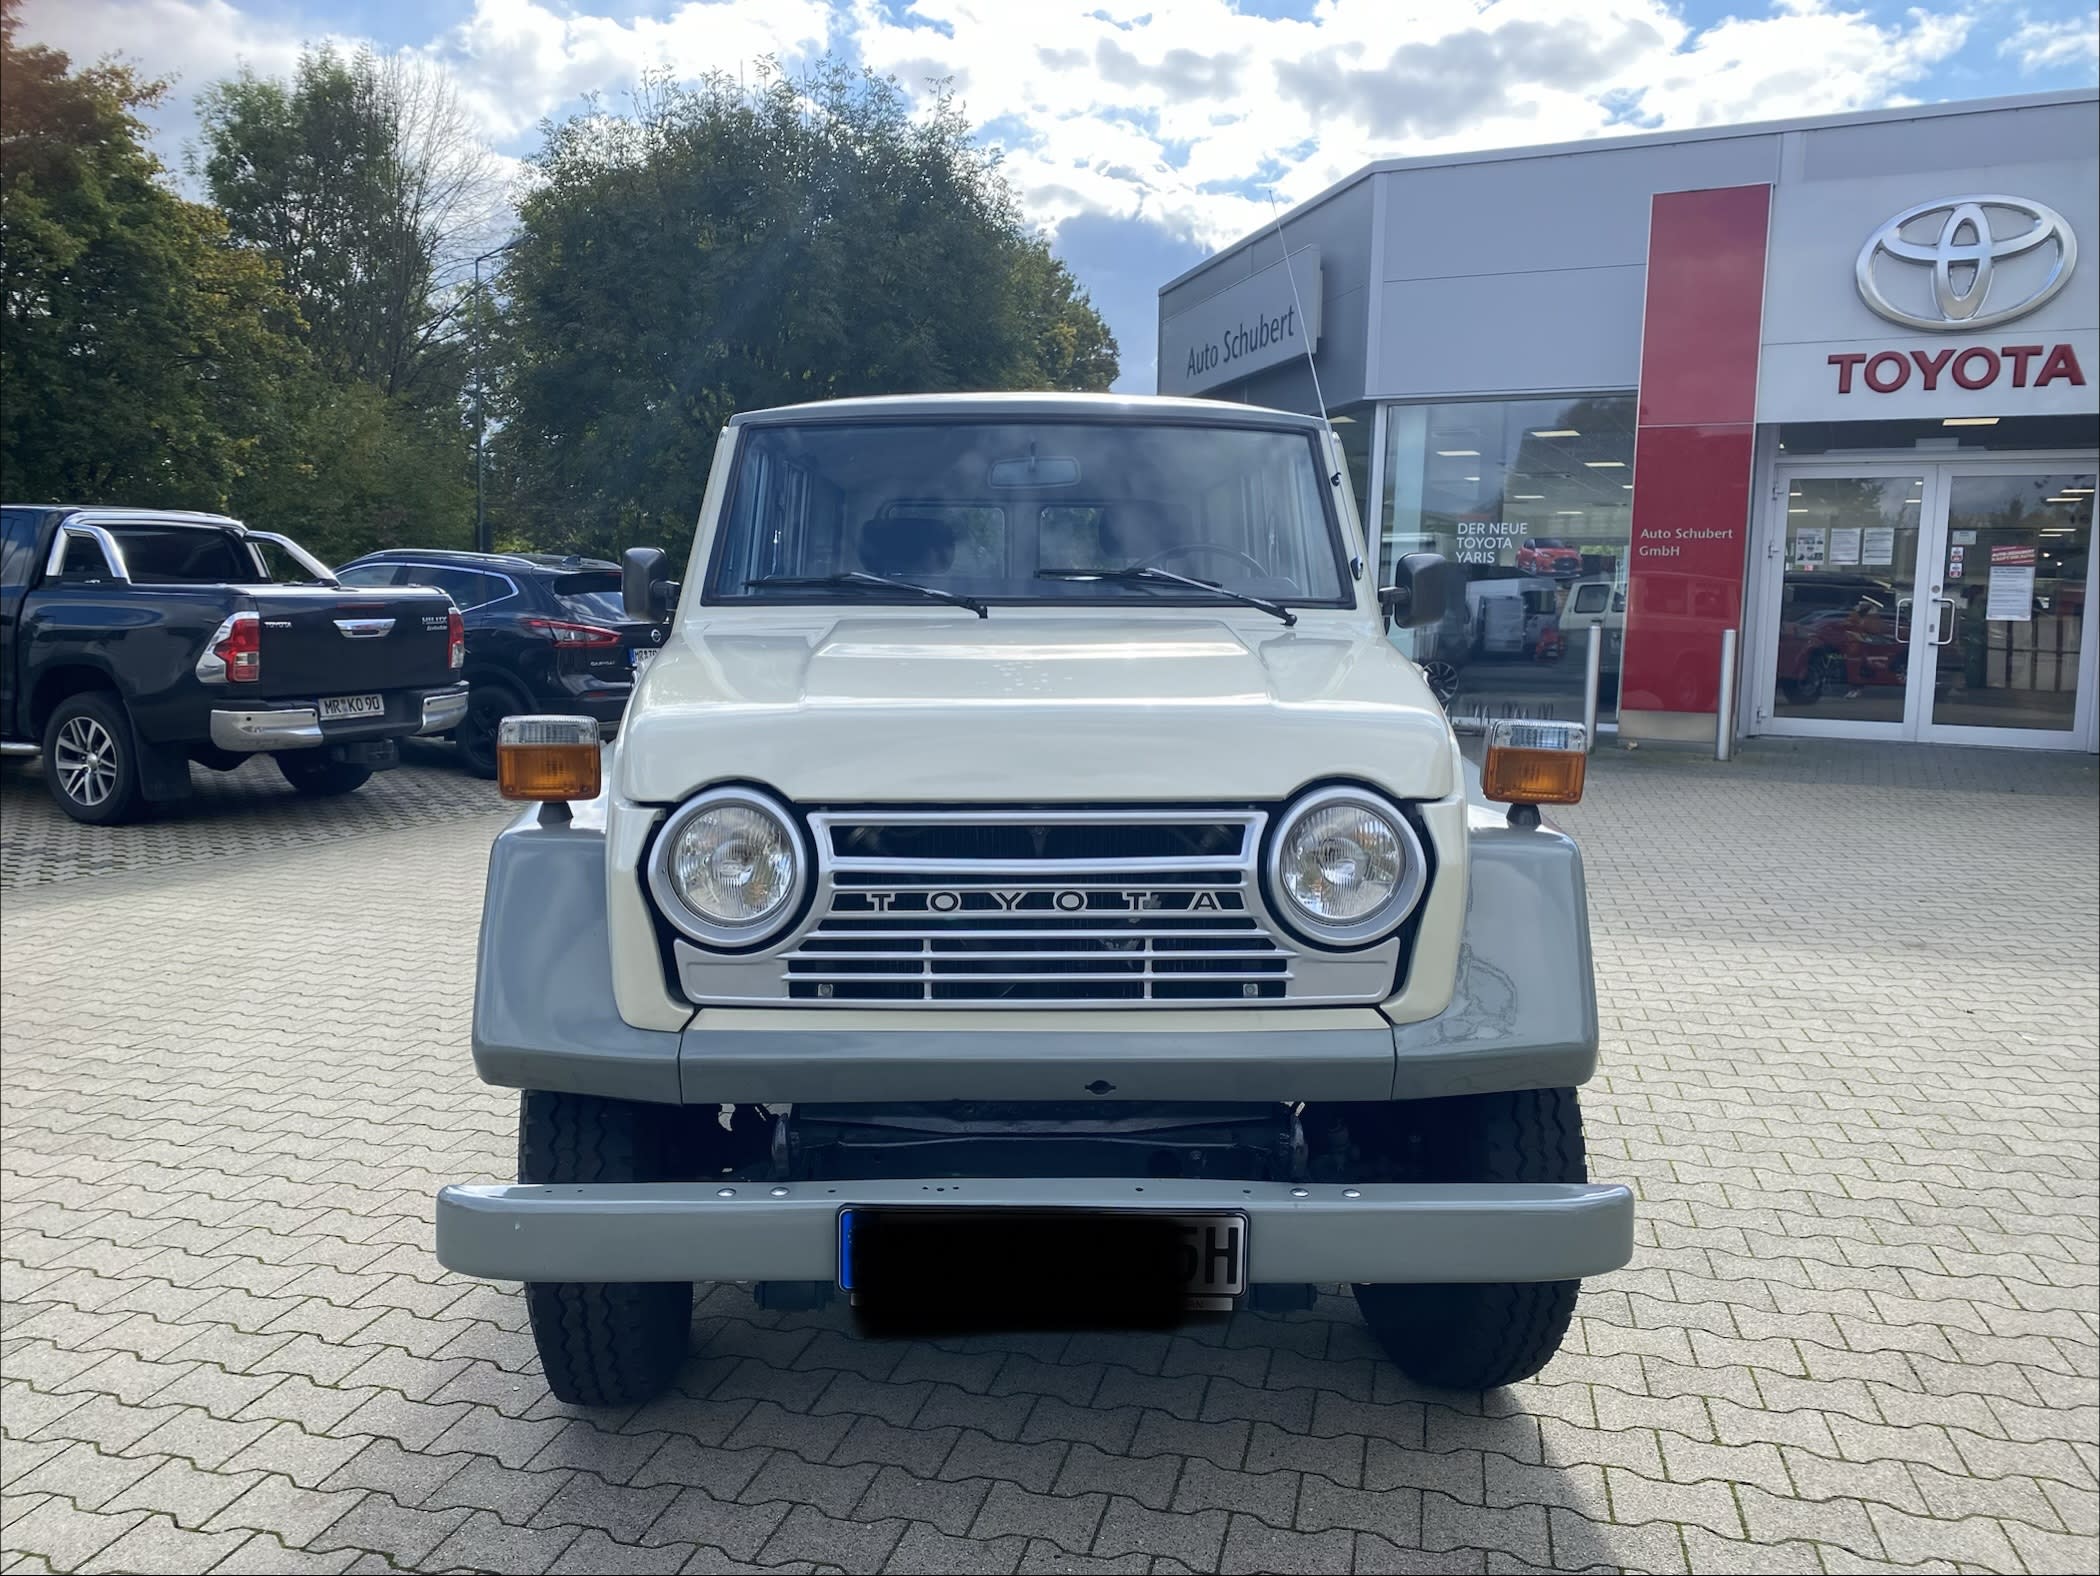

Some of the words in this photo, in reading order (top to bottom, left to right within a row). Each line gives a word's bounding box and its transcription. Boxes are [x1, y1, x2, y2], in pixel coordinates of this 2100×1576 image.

[1186, 343, 1218, 378] Auto
[1223, 305, 1294, 362] Schubert
[1827, 343, 2086, 394] TOYOTA
[1457, 522, 1485, 535] DER
[1489, 522, 1528, 535] NEUE
[1640, 528, 1671, 539] Auto
[1675, 527, 1733, 539] Schubert
[1456, 537, 1512, 549] TOYOTA
[1639, 545, 1680, 556] GmbH
[1456, 552, 1495, 564] YARIS
[324, 699, 341, 714] MR
[347, 697, 363, 712] KO
[365, 696, 380, 710] 90
[867, 890, 1222, 913] TOYOTA
